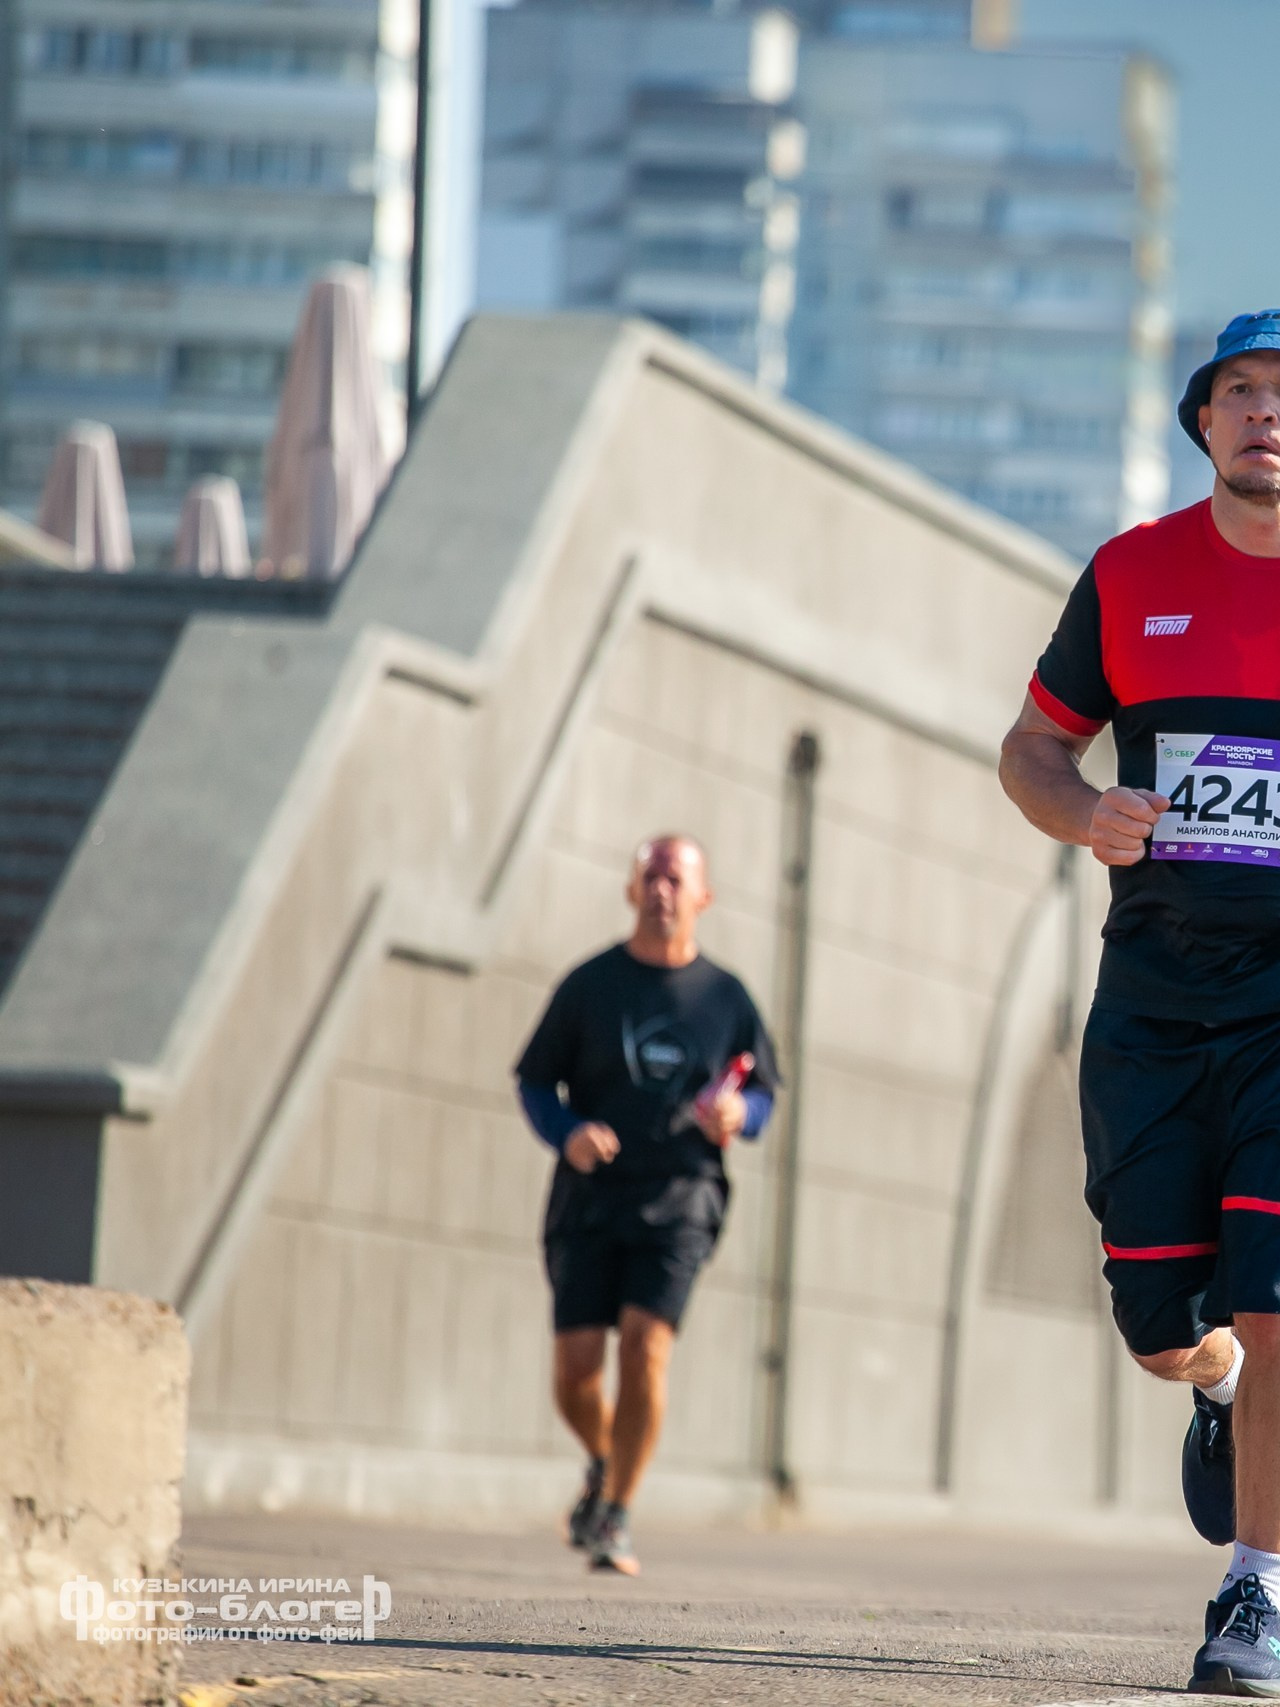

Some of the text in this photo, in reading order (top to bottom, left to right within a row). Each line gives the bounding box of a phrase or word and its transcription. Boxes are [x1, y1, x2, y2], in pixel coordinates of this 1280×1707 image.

[1174, 750, 1195, 758] СБЕР
[1211, 744, 1273, 756] КРАСНОЯРСКИЕ
[1226, 752, 1256, 761] МОСТЫ
[1176, 825, 1230, 837] МАНУЙЛОВ
